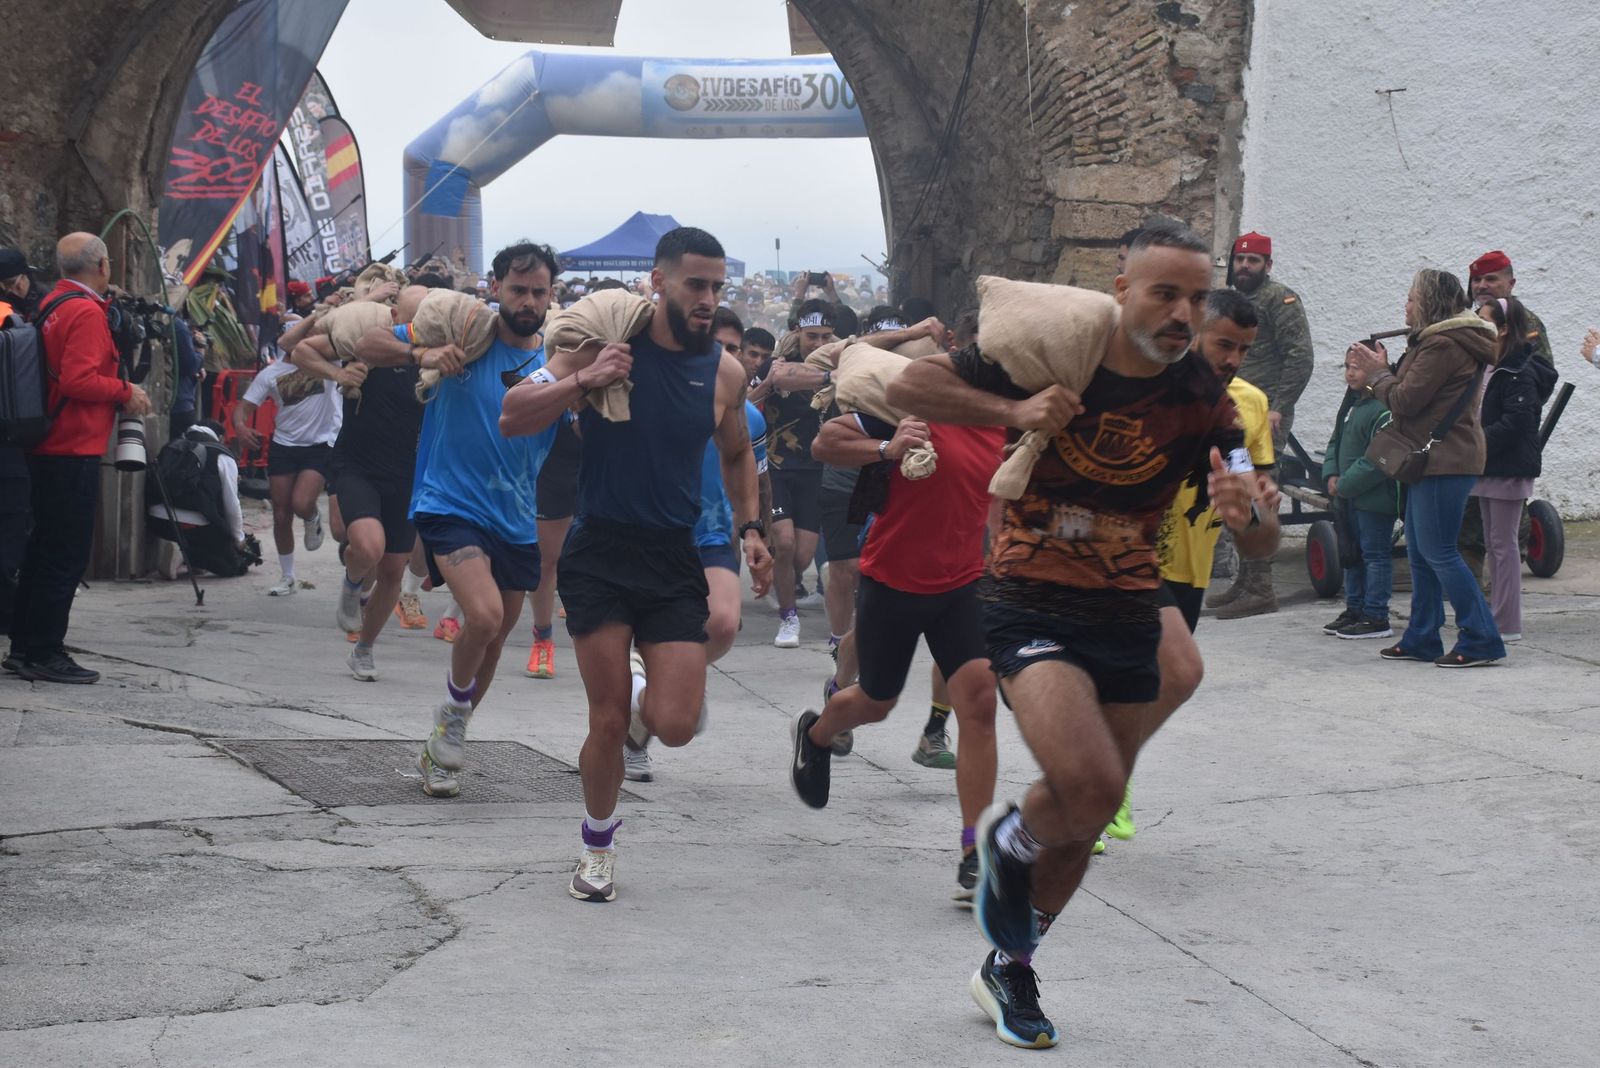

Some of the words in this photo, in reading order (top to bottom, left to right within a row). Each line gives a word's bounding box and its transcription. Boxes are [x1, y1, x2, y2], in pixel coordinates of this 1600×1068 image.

[234, 81, 263, 107] EL
[764, 98, 777, 112] DE
[781, 98, 800, 112] LOS
[191, 119, 229, 147] DE
[226, 134, 263, 161] LOS
[168, 146, 257, 184] 300
